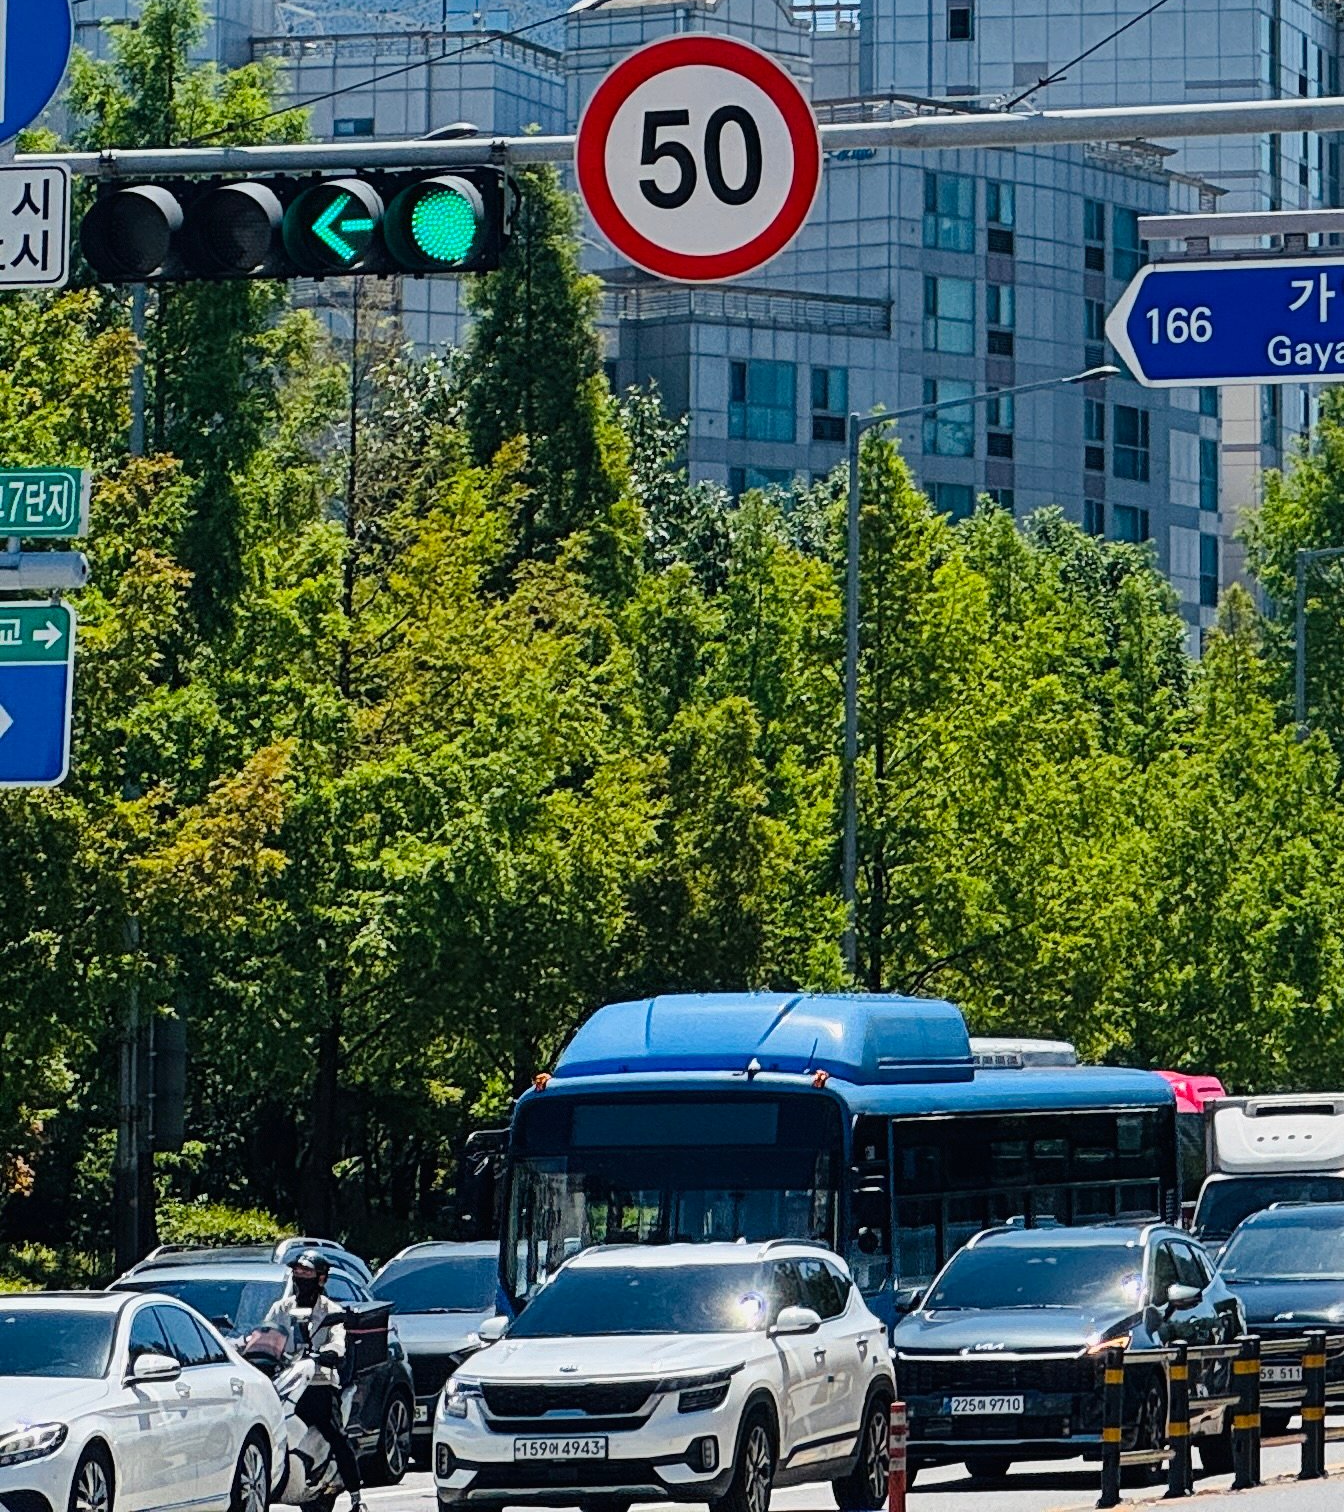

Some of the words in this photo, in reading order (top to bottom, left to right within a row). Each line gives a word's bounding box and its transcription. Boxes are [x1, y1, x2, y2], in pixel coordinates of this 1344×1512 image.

[639, 104, 763, 210] 50
[11, 178, 50, 220] 시
[0, 229, 49, 271] 시
[1145, 306, 1213, 345] 166
[0, 480, 69, 523] 7단지
[989, 1397, 1021, 1412] 9710
[521, 1441, 559, 1456] 159어
[561, 1440, 600, 1456] 4943
